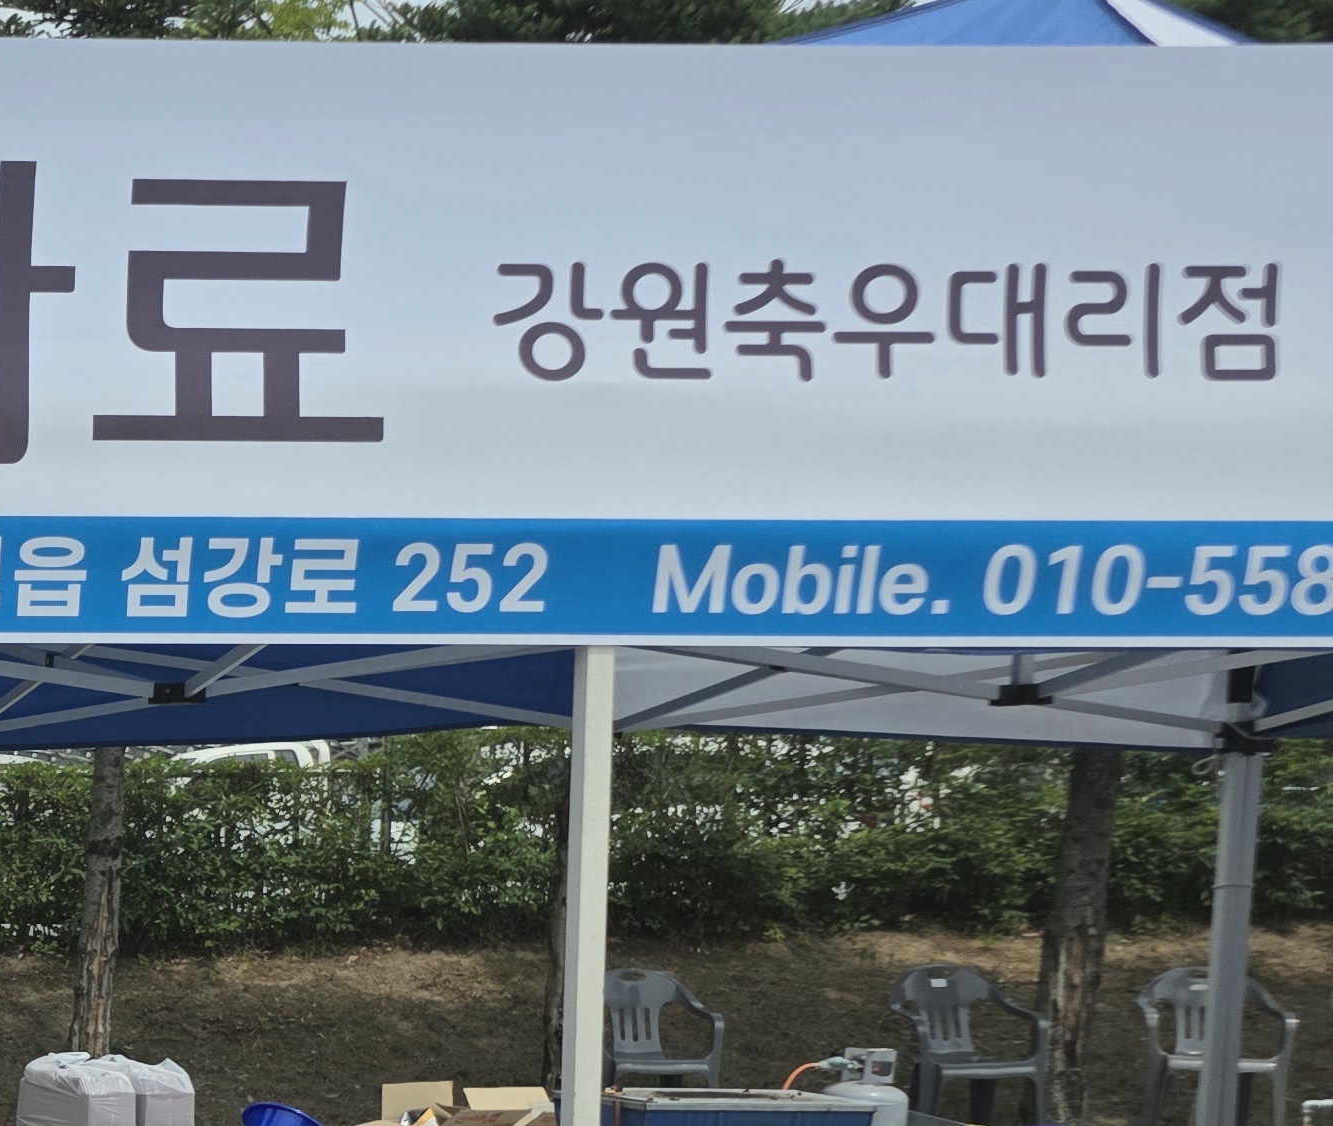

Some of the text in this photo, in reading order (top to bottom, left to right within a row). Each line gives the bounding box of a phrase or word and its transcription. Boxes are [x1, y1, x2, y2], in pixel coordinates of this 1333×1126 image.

[492, 259, 1283, 386] 강원축우대리점
[121, 536, 359, 617] 섬강로
[393, 541, 550, 615] 252
[651, 544, 950, 616] Mobile.
[982, 543, 1333, 617] 010-558
